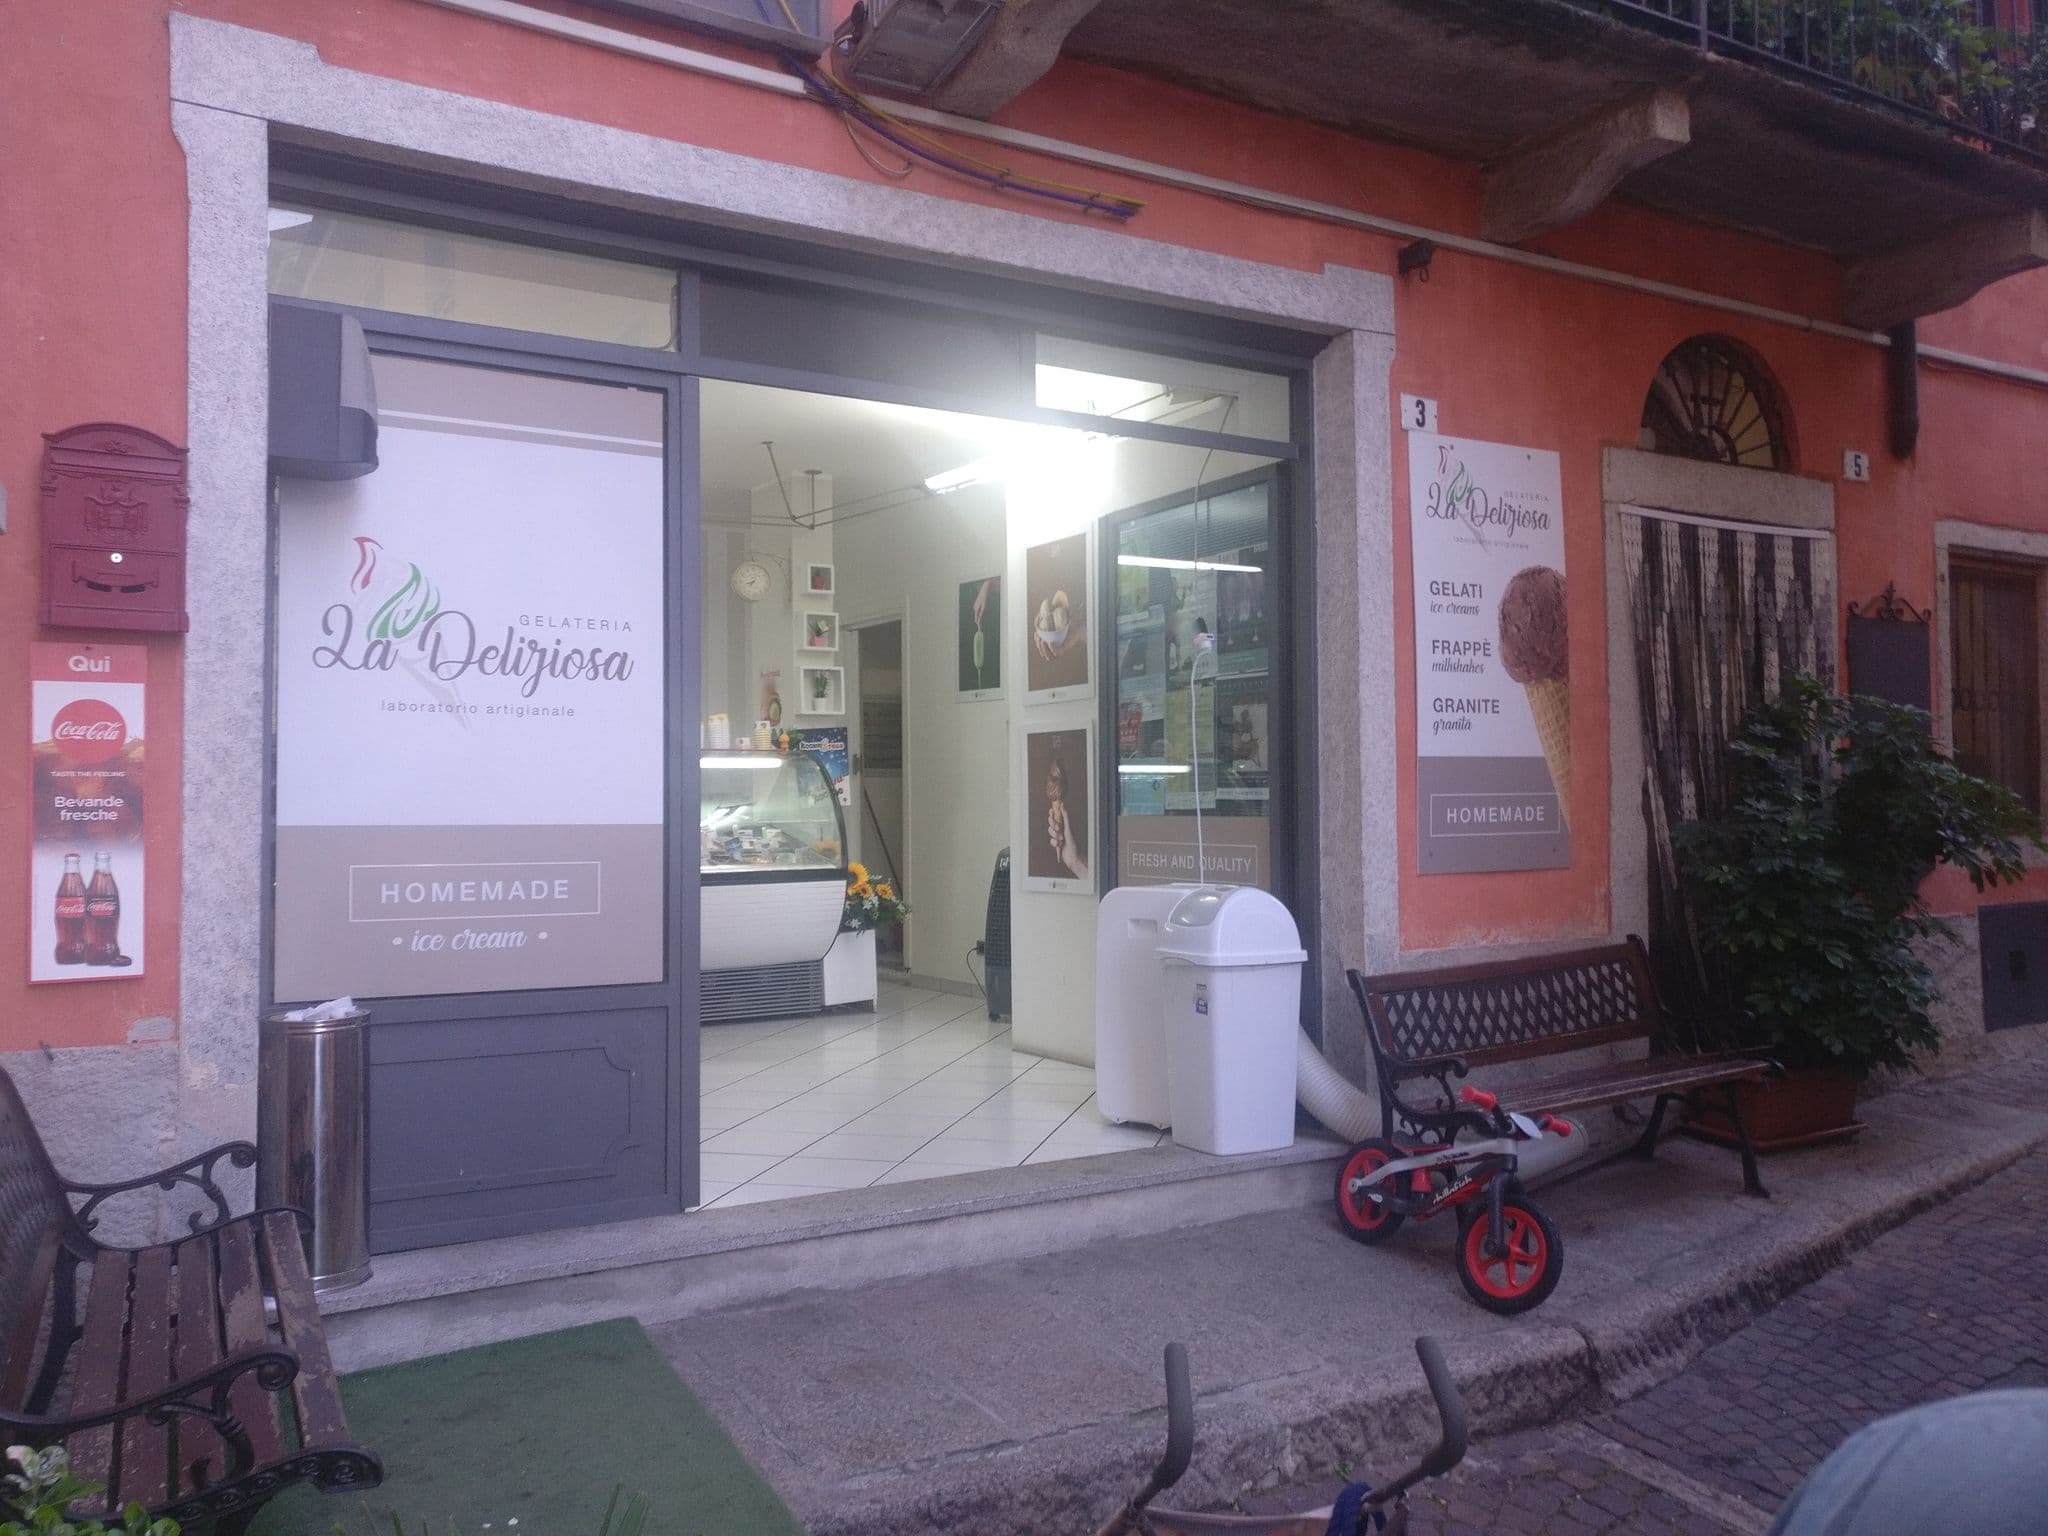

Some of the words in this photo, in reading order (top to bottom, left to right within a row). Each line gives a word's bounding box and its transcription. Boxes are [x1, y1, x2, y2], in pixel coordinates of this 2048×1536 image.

[1415, 400, 1426, 427] 3
[1854, 454, 1862, 477] 5
[1426, 482, 1459, 520] La
[1466, 487, 1551, 538] Deliziosa
[1430, 581, 1482, 599] GELATI
[1430, 602, 1443, 613] ice
[1446, 602, 1480, 615] creams
[519, 614, 632, 633] GELATERIA
[312, 604, 399, 671] La
[418, 610, 635, 698] Deliziosa
[1431, 638, 1491, 657] FRAPPÈ
[68, 655, 111, 673] Qui
[1432, 658, 1486, 674] milkshakes
[381, 700, 478, 714] laboratorio
[486, 704, 575, 718] artigianale
[1433, 697, 1500, 714] GRANITE
[1432, 716, 1472, 736] granita
[54, 796, 124, 808] Bevande
[60, 809, 118, 821] fresche
[1447, 805, 1545, 823] HOMEMADE
[1132, 853, 1167, 867] FRESH
[1170, 855, 1194, 869] AND
[381, 879, 569, 904] HOMEMADE
[411, 930, 445, 951] ice
[452, 928, 528, 951] cream
